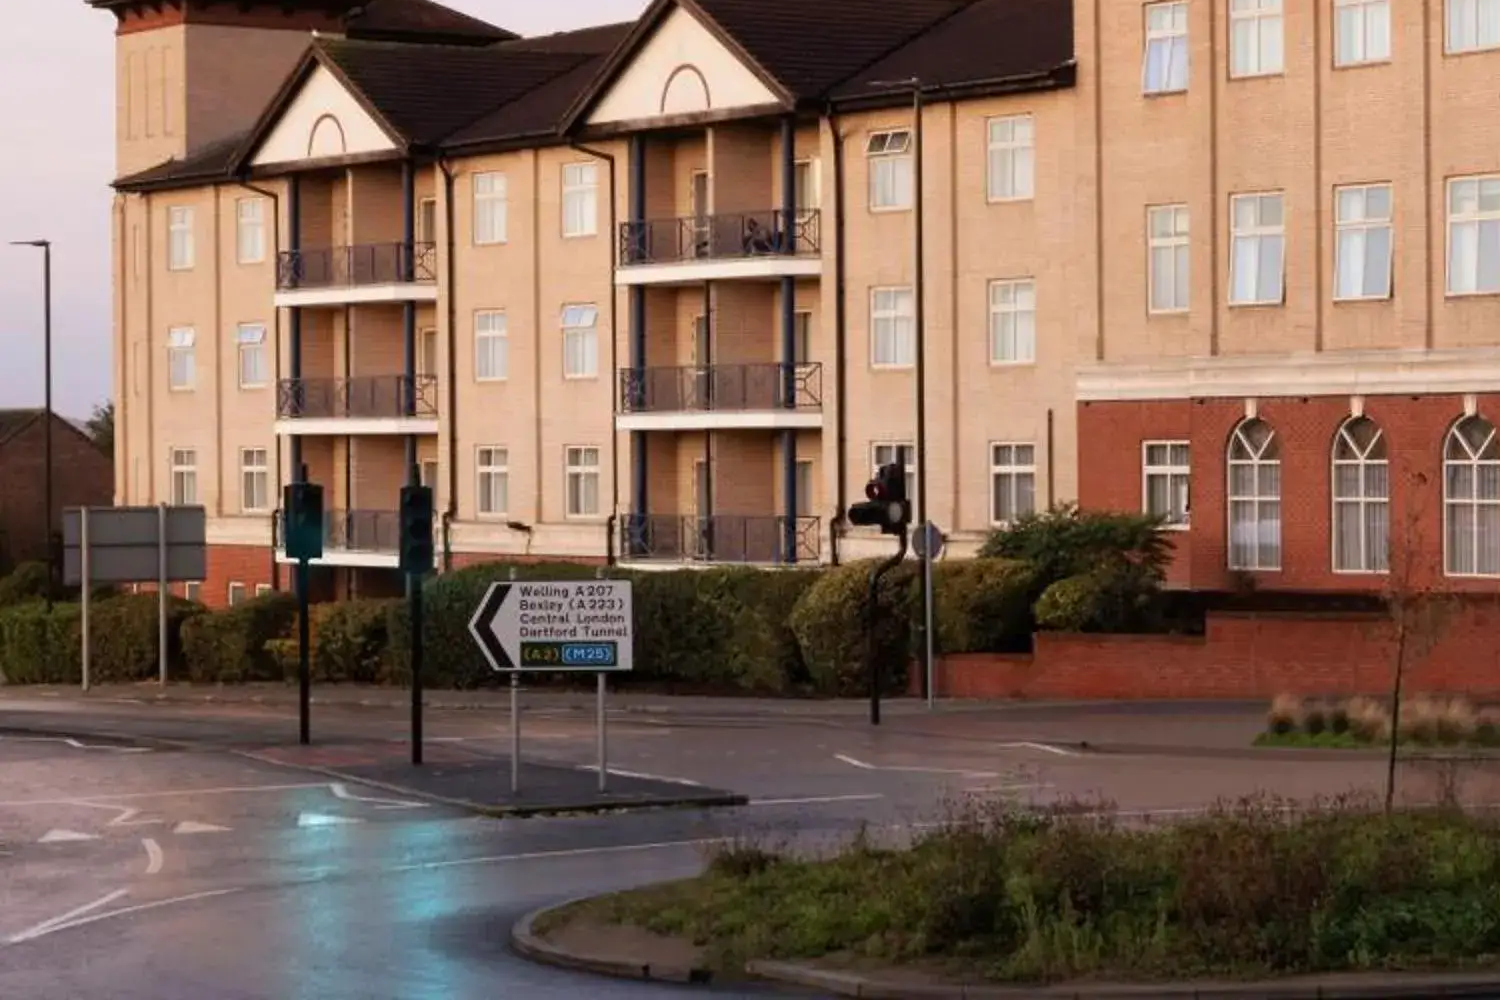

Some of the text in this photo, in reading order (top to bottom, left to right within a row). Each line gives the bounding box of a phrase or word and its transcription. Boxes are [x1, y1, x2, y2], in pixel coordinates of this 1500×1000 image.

[520, 585, 614, 598] Welling A207
[520, 598, 624, 612] Bexley (A223)
[520, 613, 625, 624] Central London
[520, 625, 627, 638] Dartford Tunnel
[565, 647, 611, 659] (M25)
